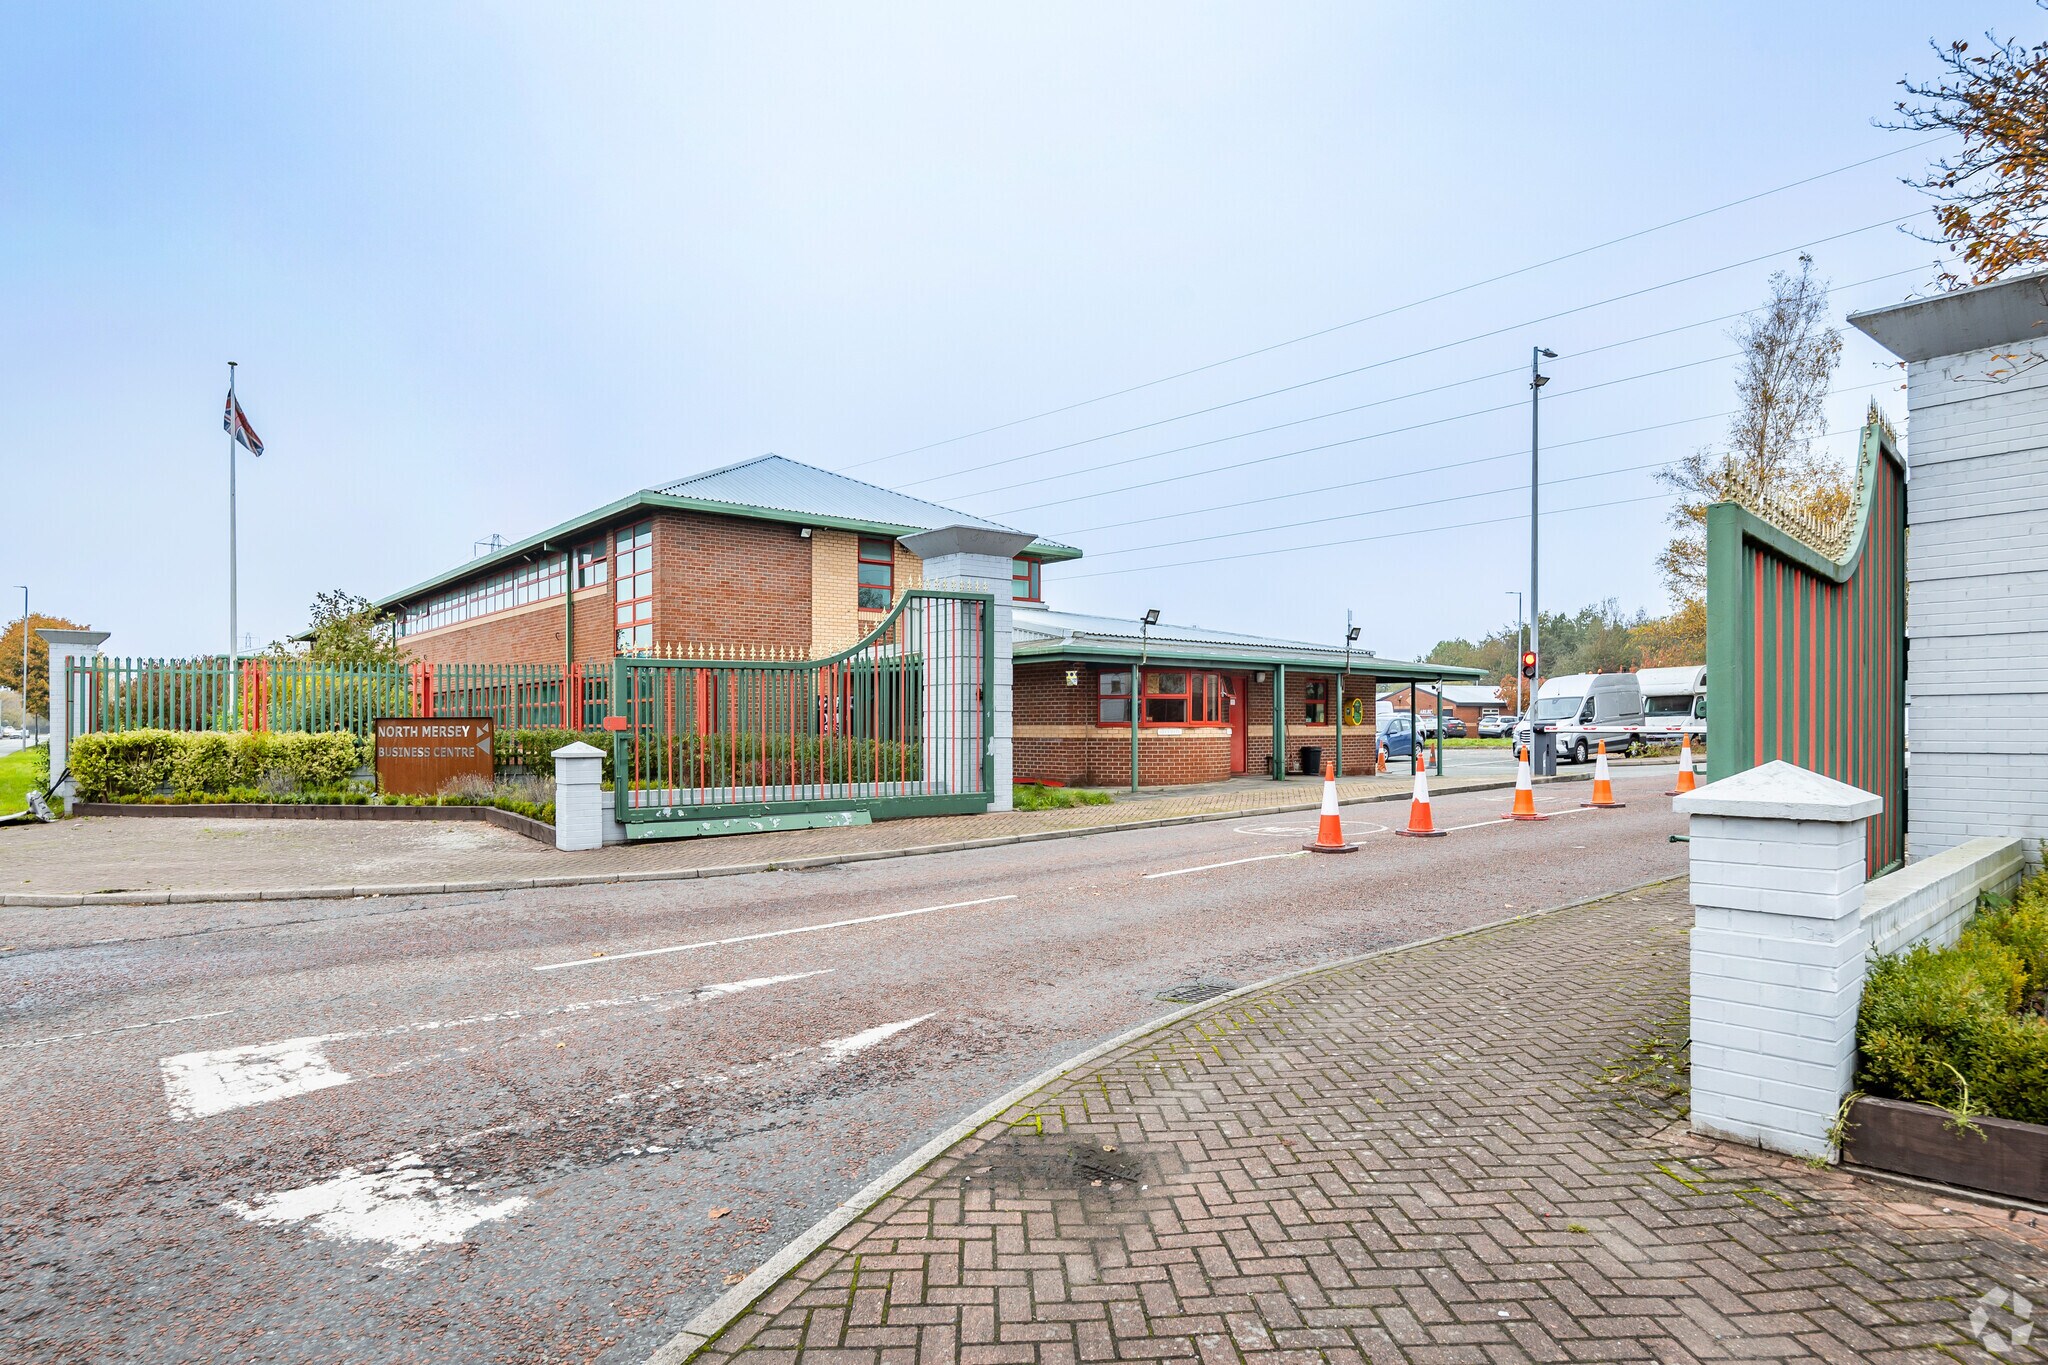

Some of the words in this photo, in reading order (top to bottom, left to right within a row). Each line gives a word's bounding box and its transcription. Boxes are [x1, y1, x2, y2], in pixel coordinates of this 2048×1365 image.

[378, 726, 418, 737] NORTH
[422, 726, 470, 737] MERSEY
[378, 747, 430, 757] BUSINESS
[434, 747, 474, 757] CENTRE
